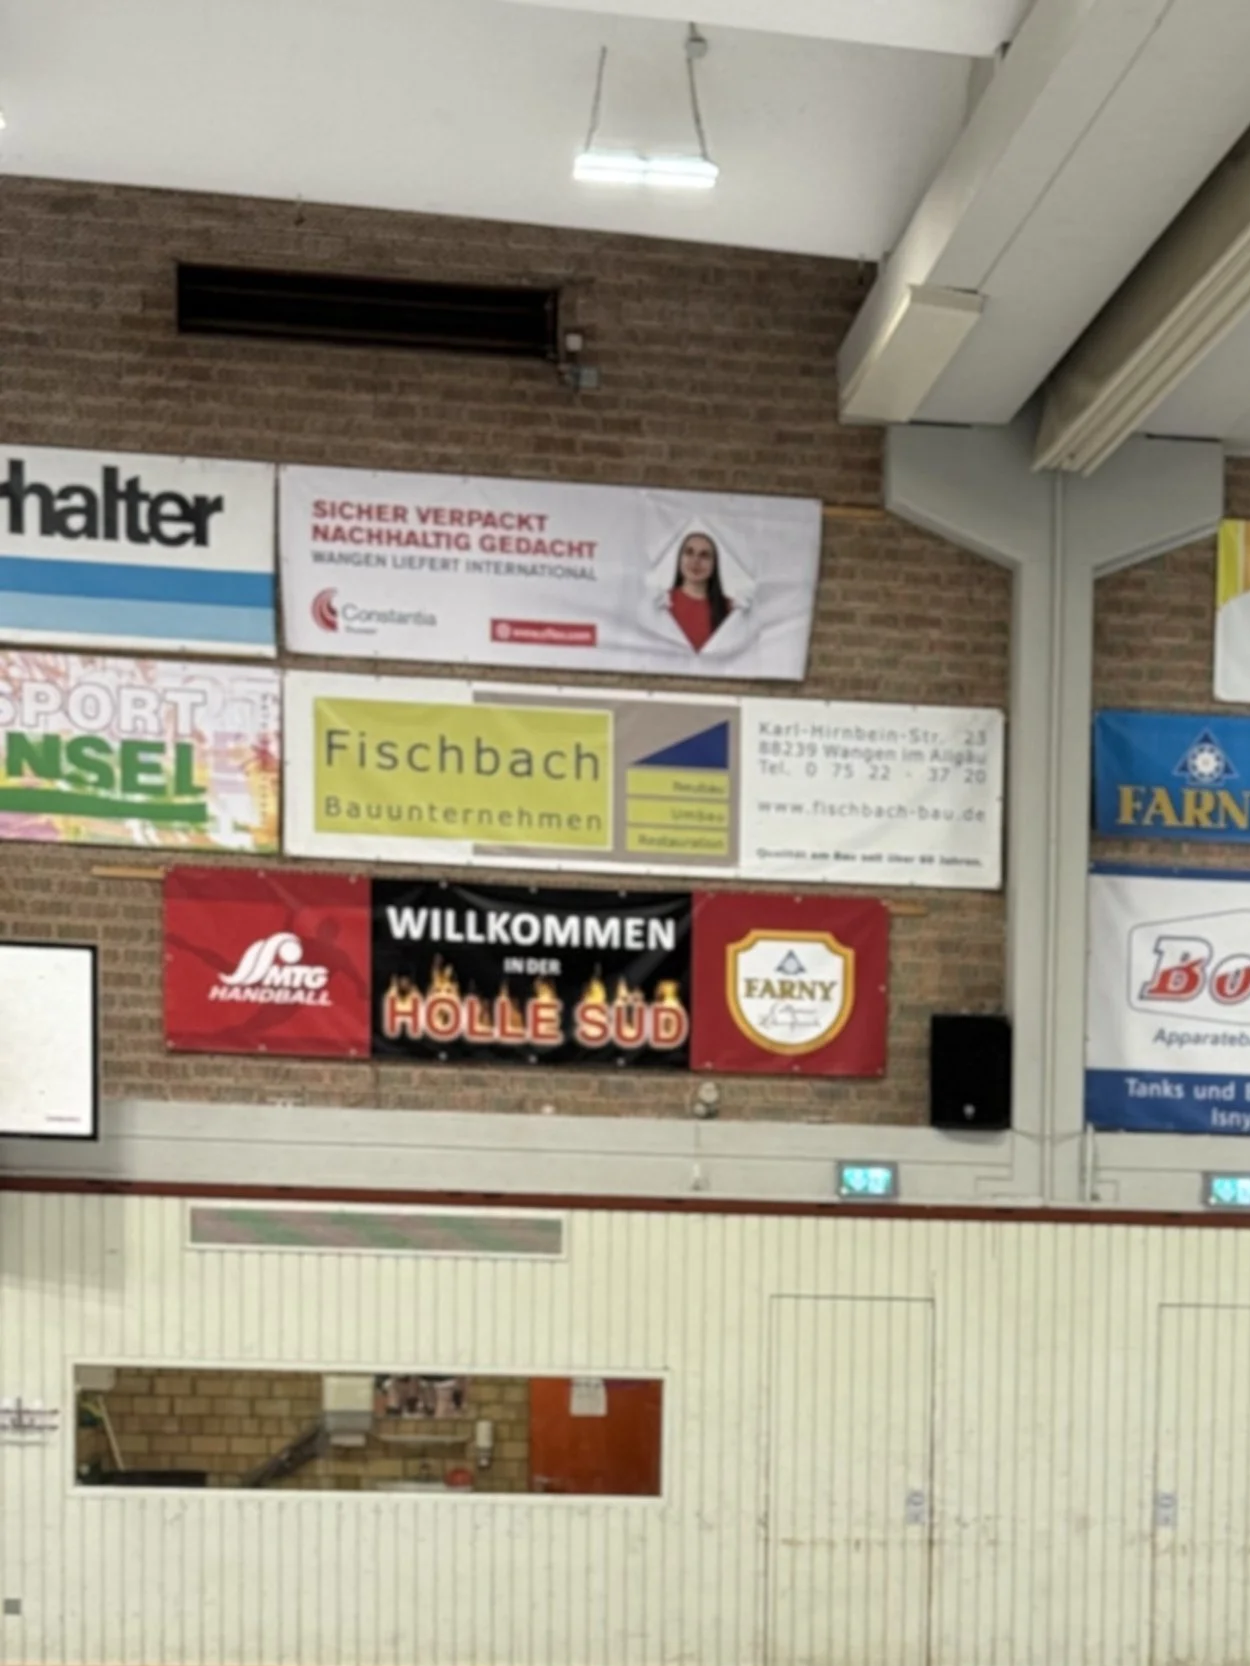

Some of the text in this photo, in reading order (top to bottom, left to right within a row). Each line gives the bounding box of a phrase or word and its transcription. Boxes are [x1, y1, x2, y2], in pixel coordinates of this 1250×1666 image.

[311, 499, 549, 533] SICHER VERPACKT
[311, 523, 598, 560] NACHHALTIG GEDACHT
[311, 550, 598, 582] WANGEN LIEFERT INTERNATIONAL
[340, 602, 438, 628] Constantia
[5, 731, 208, 797] NSEL
[324, 727, 601, 782] Fischbach
[758, 741, 987, 772] 88239 Wangen im Allgäu
[758, 758, 987, 784] Tel. 0 75 22 37 20
[323, 796, 603, 832] Bauunternehmen
[386, 905, 676, 951] WILLKOMMEN
[264, 964, 330, 989] MTG
[503, 956, 561, 975] IN DER
[208, 984, 333, 1007] HANDBALL
[744, 976, 839, 1002] FARNY
[576, 989, 687, 1048] SÜD
[1125, 1076, 1185, 1099] Tanks
[1193, 1081, 1236, 1101] und
